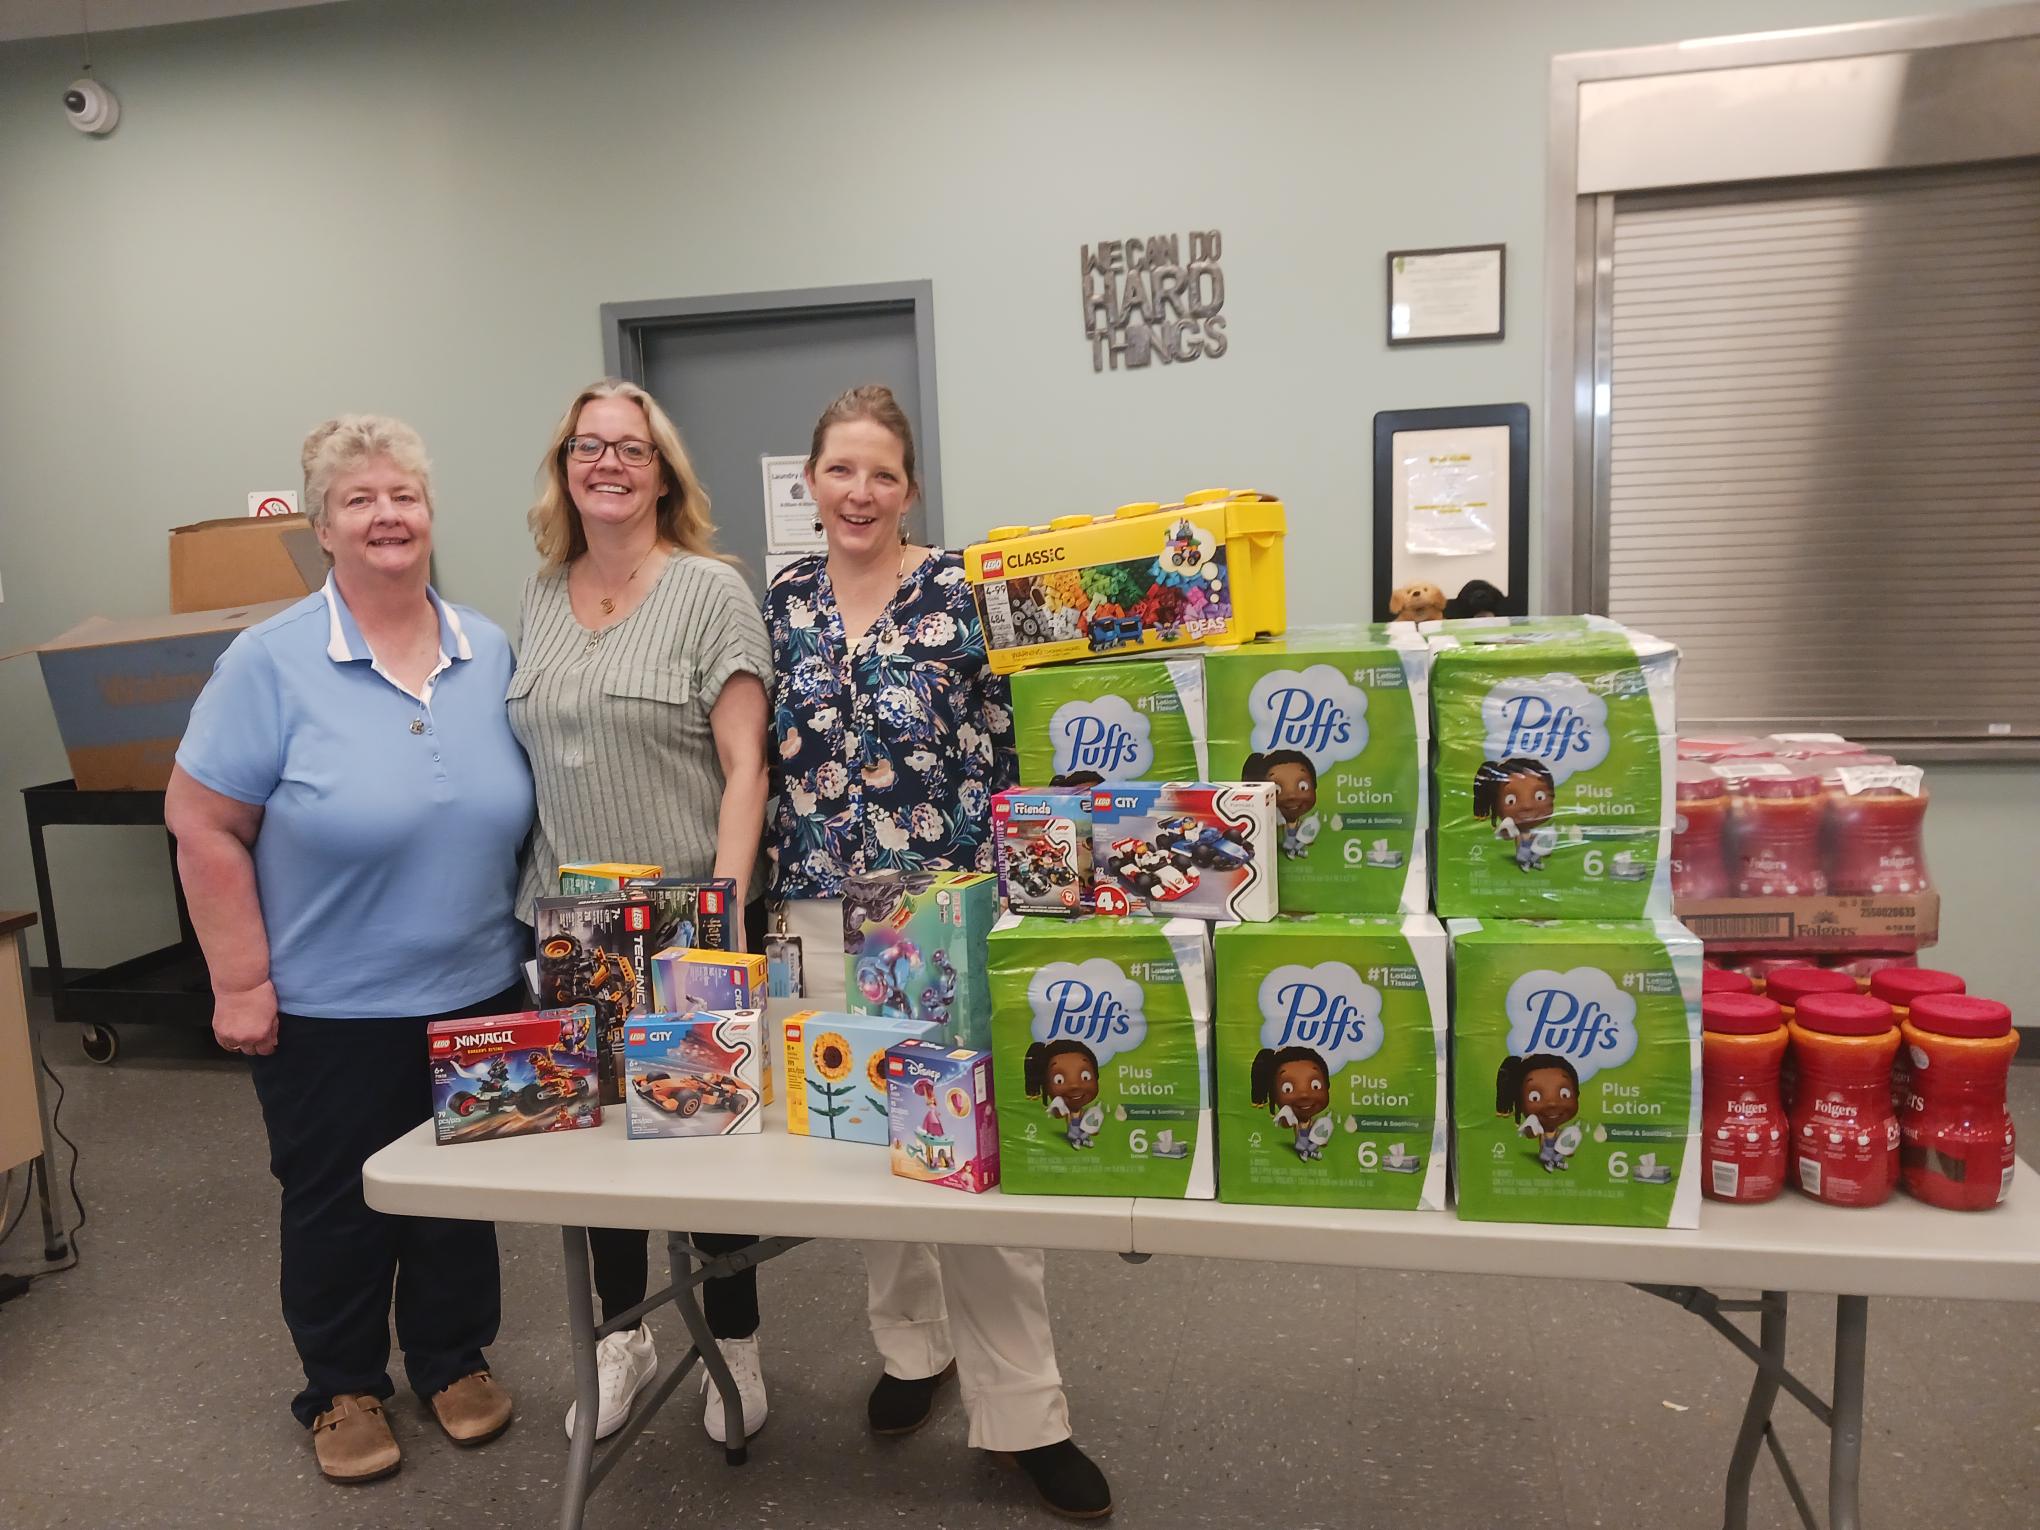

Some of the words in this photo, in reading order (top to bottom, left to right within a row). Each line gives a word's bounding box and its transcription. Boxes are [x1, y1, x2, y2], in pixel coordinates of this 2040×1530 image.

[1189, 230, 1222, 262] DO
[1082, 262, 1225, 339] HARD
[1088, 315, 1228, 372] THINGS
[984, 560, 1001, 569] LEGO
[1007, 547, 1065, 569] CLASSIC
[1354, 669, 1375, 687] #1
[1137, 696, 1155, 712] #1
[1267, 688, 1350, 753] Puffs
[1501, 695, 1592, 761] Puffs
[1065, 716, 1138, 772] Puffs
[1336, 774, 1372, 787] Plus
[1337, 790, 1393, 804] Lotion
[1576, 784, 1613, 798] Plus
[1014, 801, 1051, 815] Friends
[1094, 797, 1111, 806] LEGO
[1115, 797, 1139, 808] CITY
[1343, 838, 1363, 864] 6
[1583, 850, 1604, 876] 6
[706, 892, 717, 913] LEGO
[1096, 892, 1124, 911] 4+
[611, 908, 621, 920] 7+
[631, 908, 644, 930] LEGO
[1797, 925, 1857, 937] Folgers
[634, 935, 646, 1004] TECHNIC
[1130, 962, 1150, 981] #1
[1367, 967, 1389, 986] #1
[1623, 973, 1645, 992] #1
[734, 989, 743, 1010] CREA
[1046, 980, 1130, 1043] Puffs
[1277, 983, 1366, 1051] Puffs
[1526, 989, 1619, 1059] Puffs
[432, 1040, 450, 1048] LEGO
[453, 1030, 517, 1050] NINJAGO
[629, 1033, 645, 1041] LEGO
[649, 1031, 672, 1042] CITY
[905, 1059, 941, 1084] Disney
[1119, 1065, 1153, 1079] Plus
[1119, 1082, 1174, 1095] Lotion
[1351, 1075, 1388, 1089] Plus
[1602, 1083, 1640, 1097] Plus
[1351, 1092, 1409, 1106] Lotion
[1602, 1100, 1661, 1115] Lotion
[1727, 1101, 1768, 1116] Folgers
[1815, 1099, 1857, 1118] Folgers
[1129, 1128, 1149, 1154] 6
[1358, 1141, 1379, 1168] 6
[1608, 1151, 1629, 1178] 6
